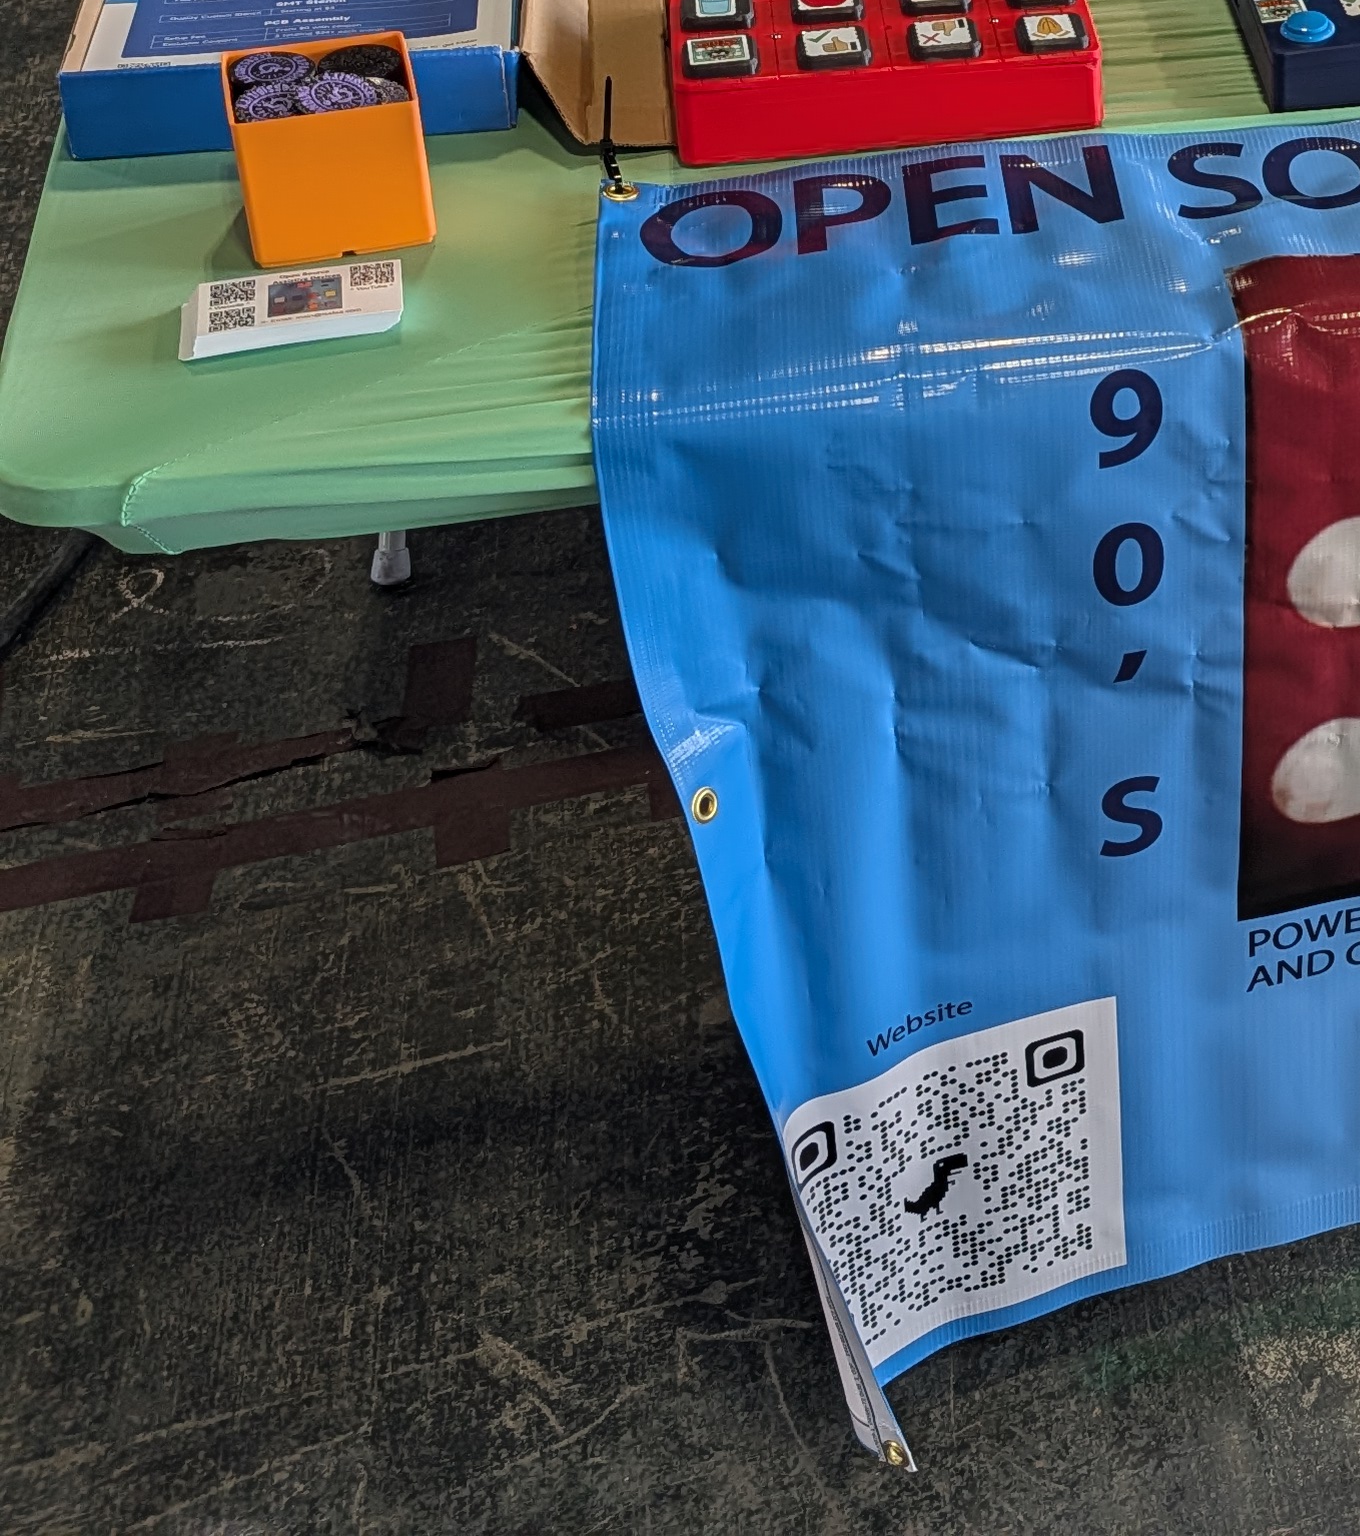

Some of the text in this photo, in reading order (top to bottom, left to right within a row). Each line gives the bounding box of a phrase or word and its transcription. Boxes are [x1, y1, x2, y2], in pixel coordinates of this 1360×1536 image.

[293, 15, 351, 24] Assembly
[639, 144, 1128, 268] OPEN
[1246, 950, 1335, 994] AND
[866, 998, 974, 1057] Website
